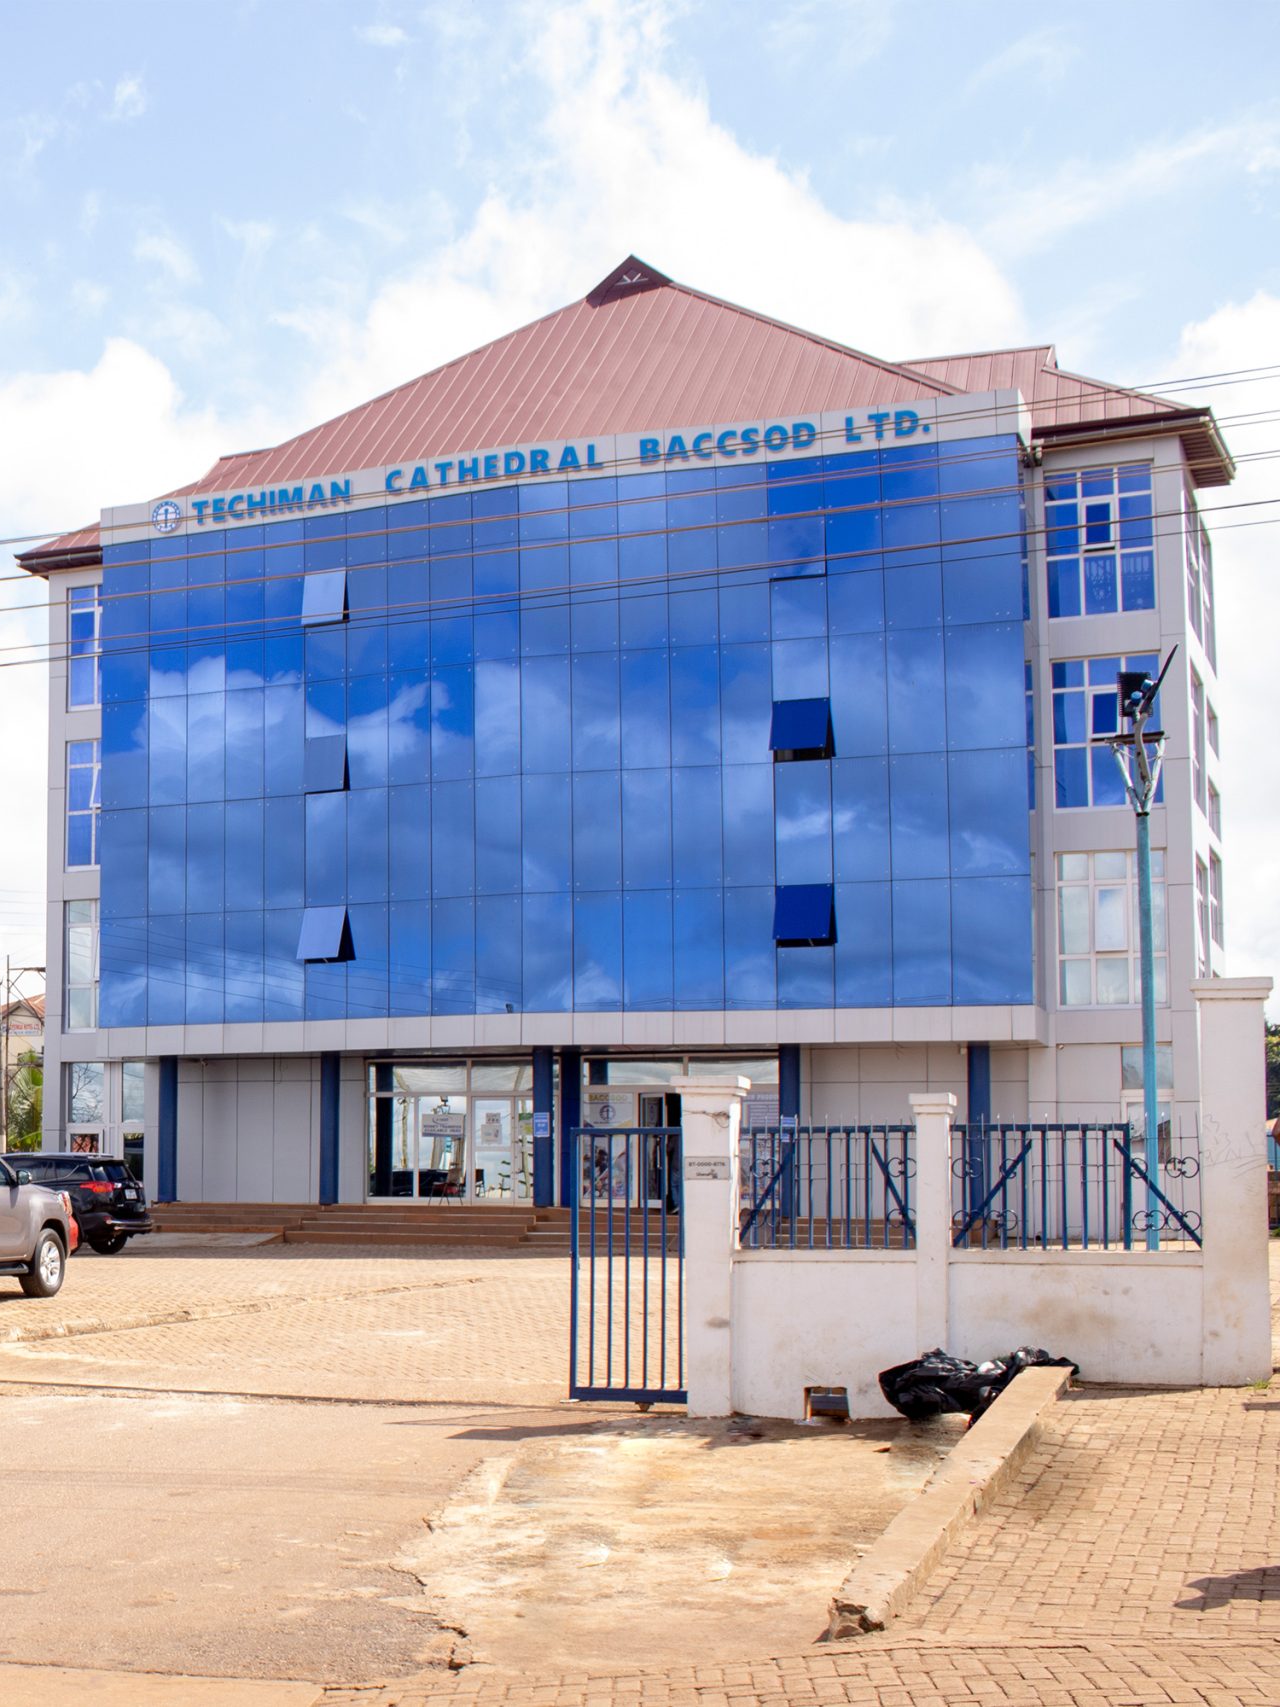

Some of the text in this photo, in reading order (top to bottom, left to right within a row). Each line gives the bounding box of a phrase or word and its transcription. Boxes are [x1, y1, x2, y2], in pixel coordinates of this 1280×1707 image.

[192, 409, 931, 525] TECHIMAN CATHEDRAL BACCSOD LTD.
